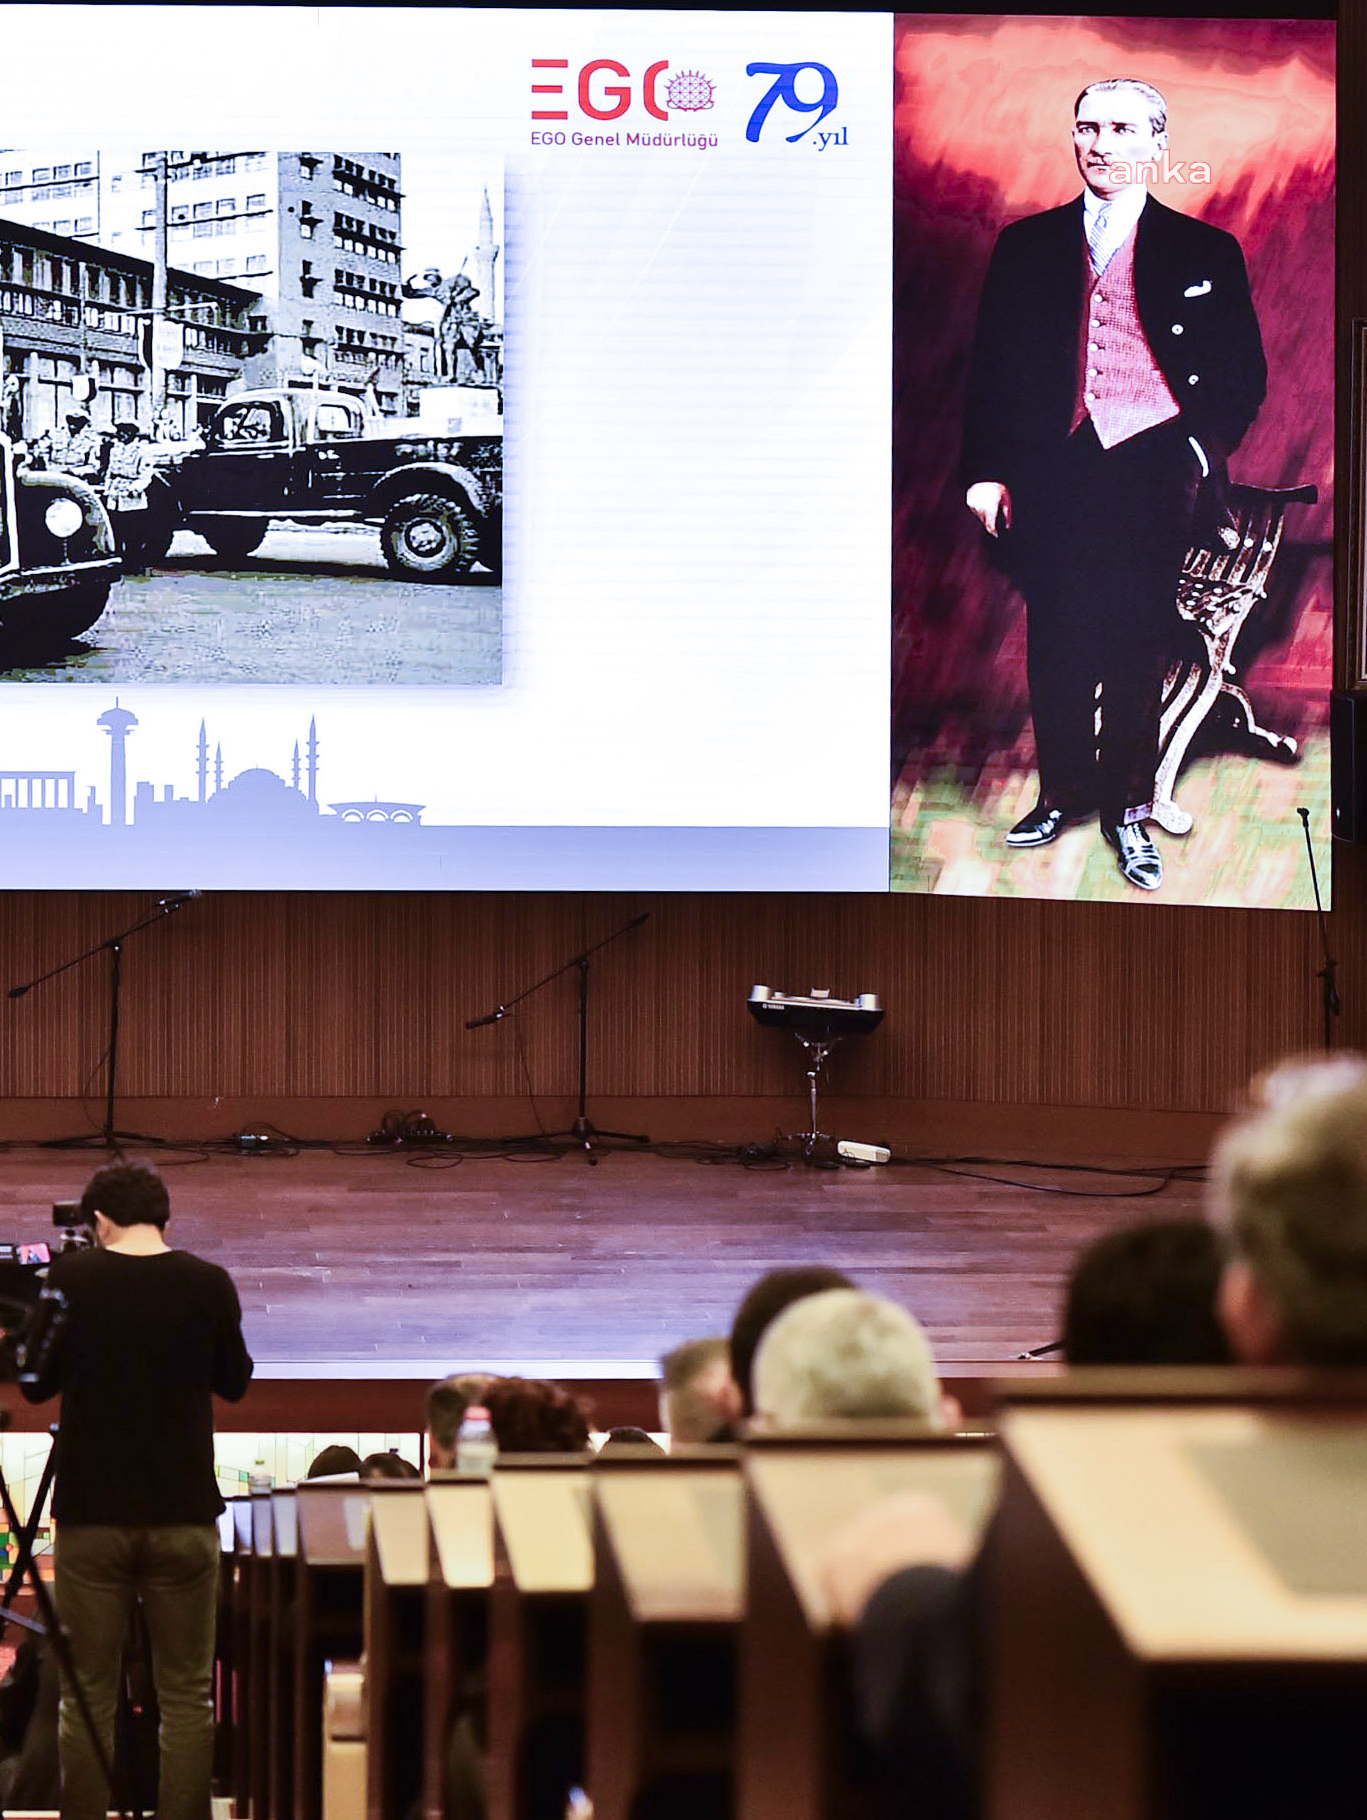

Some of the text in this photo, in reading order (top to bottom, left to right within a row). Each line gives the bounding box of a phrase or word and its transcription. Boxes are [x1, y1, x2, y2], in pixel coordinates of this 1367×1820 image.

[531, 131, 718, 151] EGO Genel Müdürlüğü
